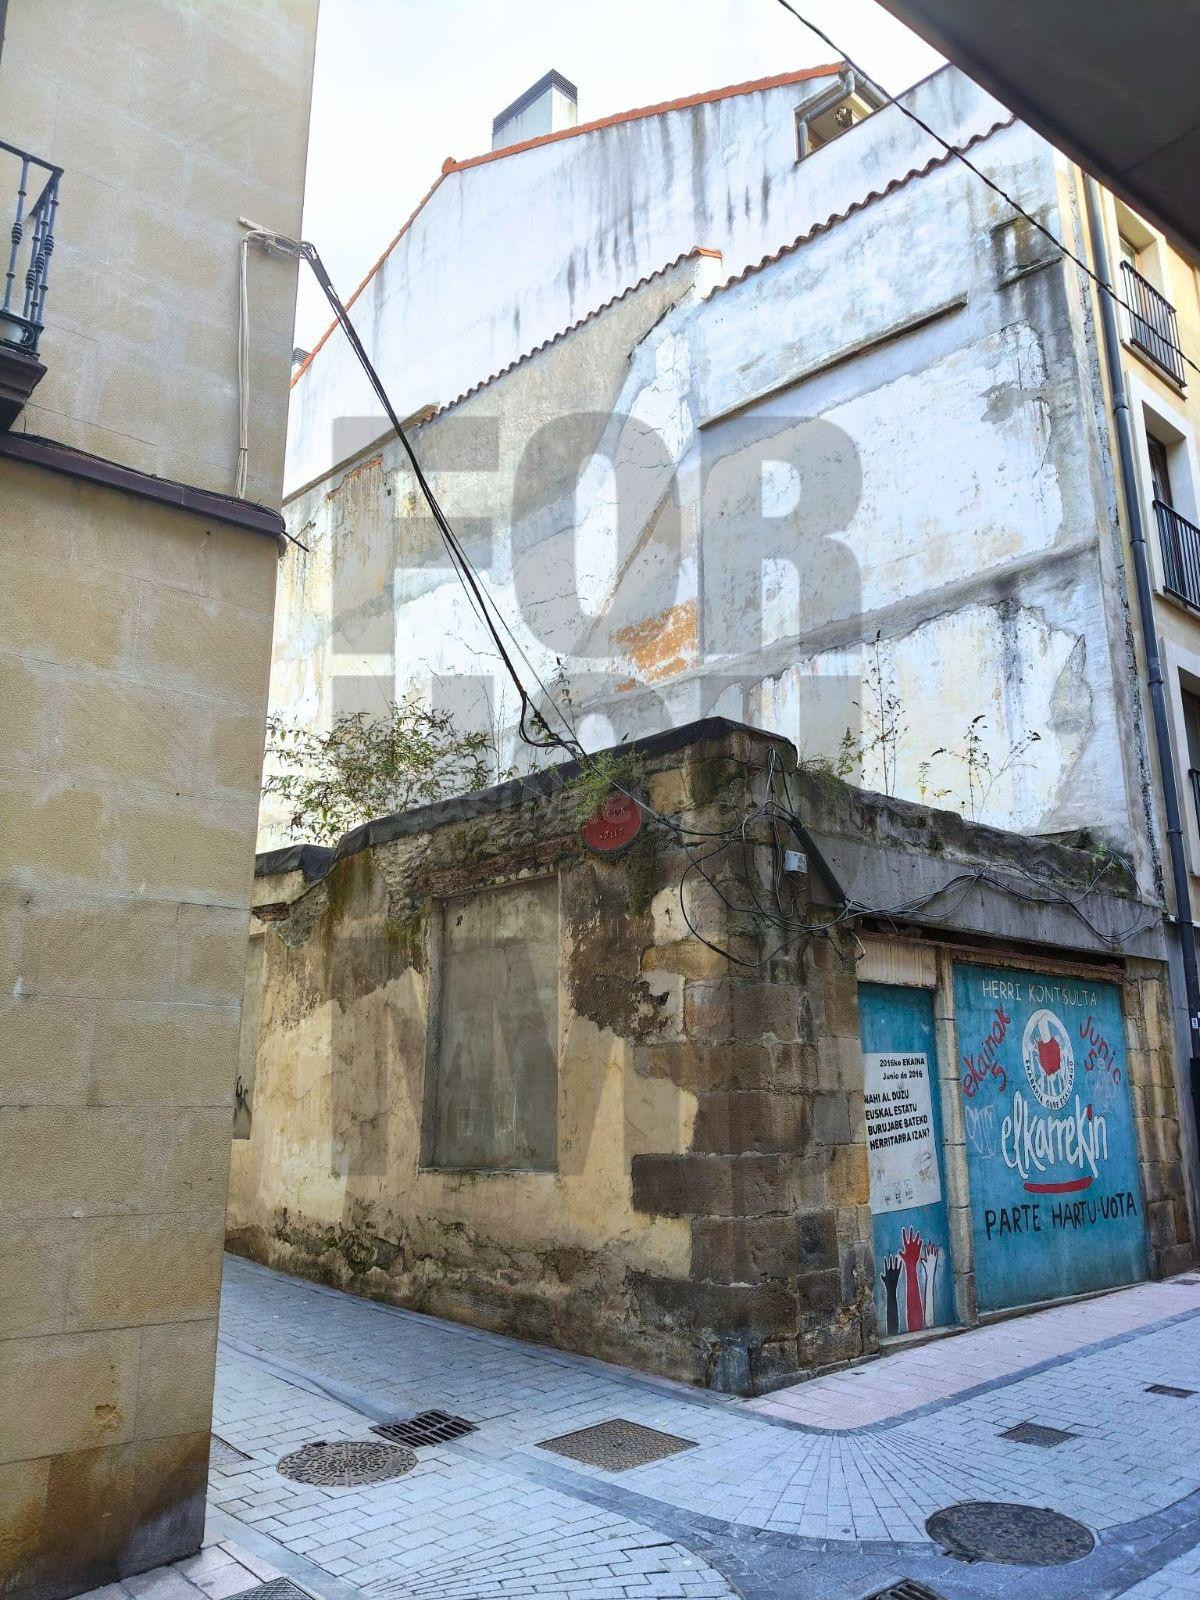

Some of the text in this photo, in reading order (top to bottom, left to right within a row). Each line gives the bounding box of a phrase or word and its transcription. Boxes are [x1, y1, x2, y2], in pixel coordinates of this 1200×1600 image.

[982, 979, 1097, 1006] HERRI KONTSULTA
[903, 1058, 925, 1066] EKAINA
[883, 1070, 923, 1080] Junio de 2016
[864, 1089, 909, 1104] NAHI AL DUZU
[865, 1103, 918, 1121] EUSKAL ESTATU
[868, 1114, 928, 1136] BURUJABE BATEKO
[870, 1128, 930, 1151] HERRITARRA IZAN?
[985, 1204, 1041, 1240] PARTE
